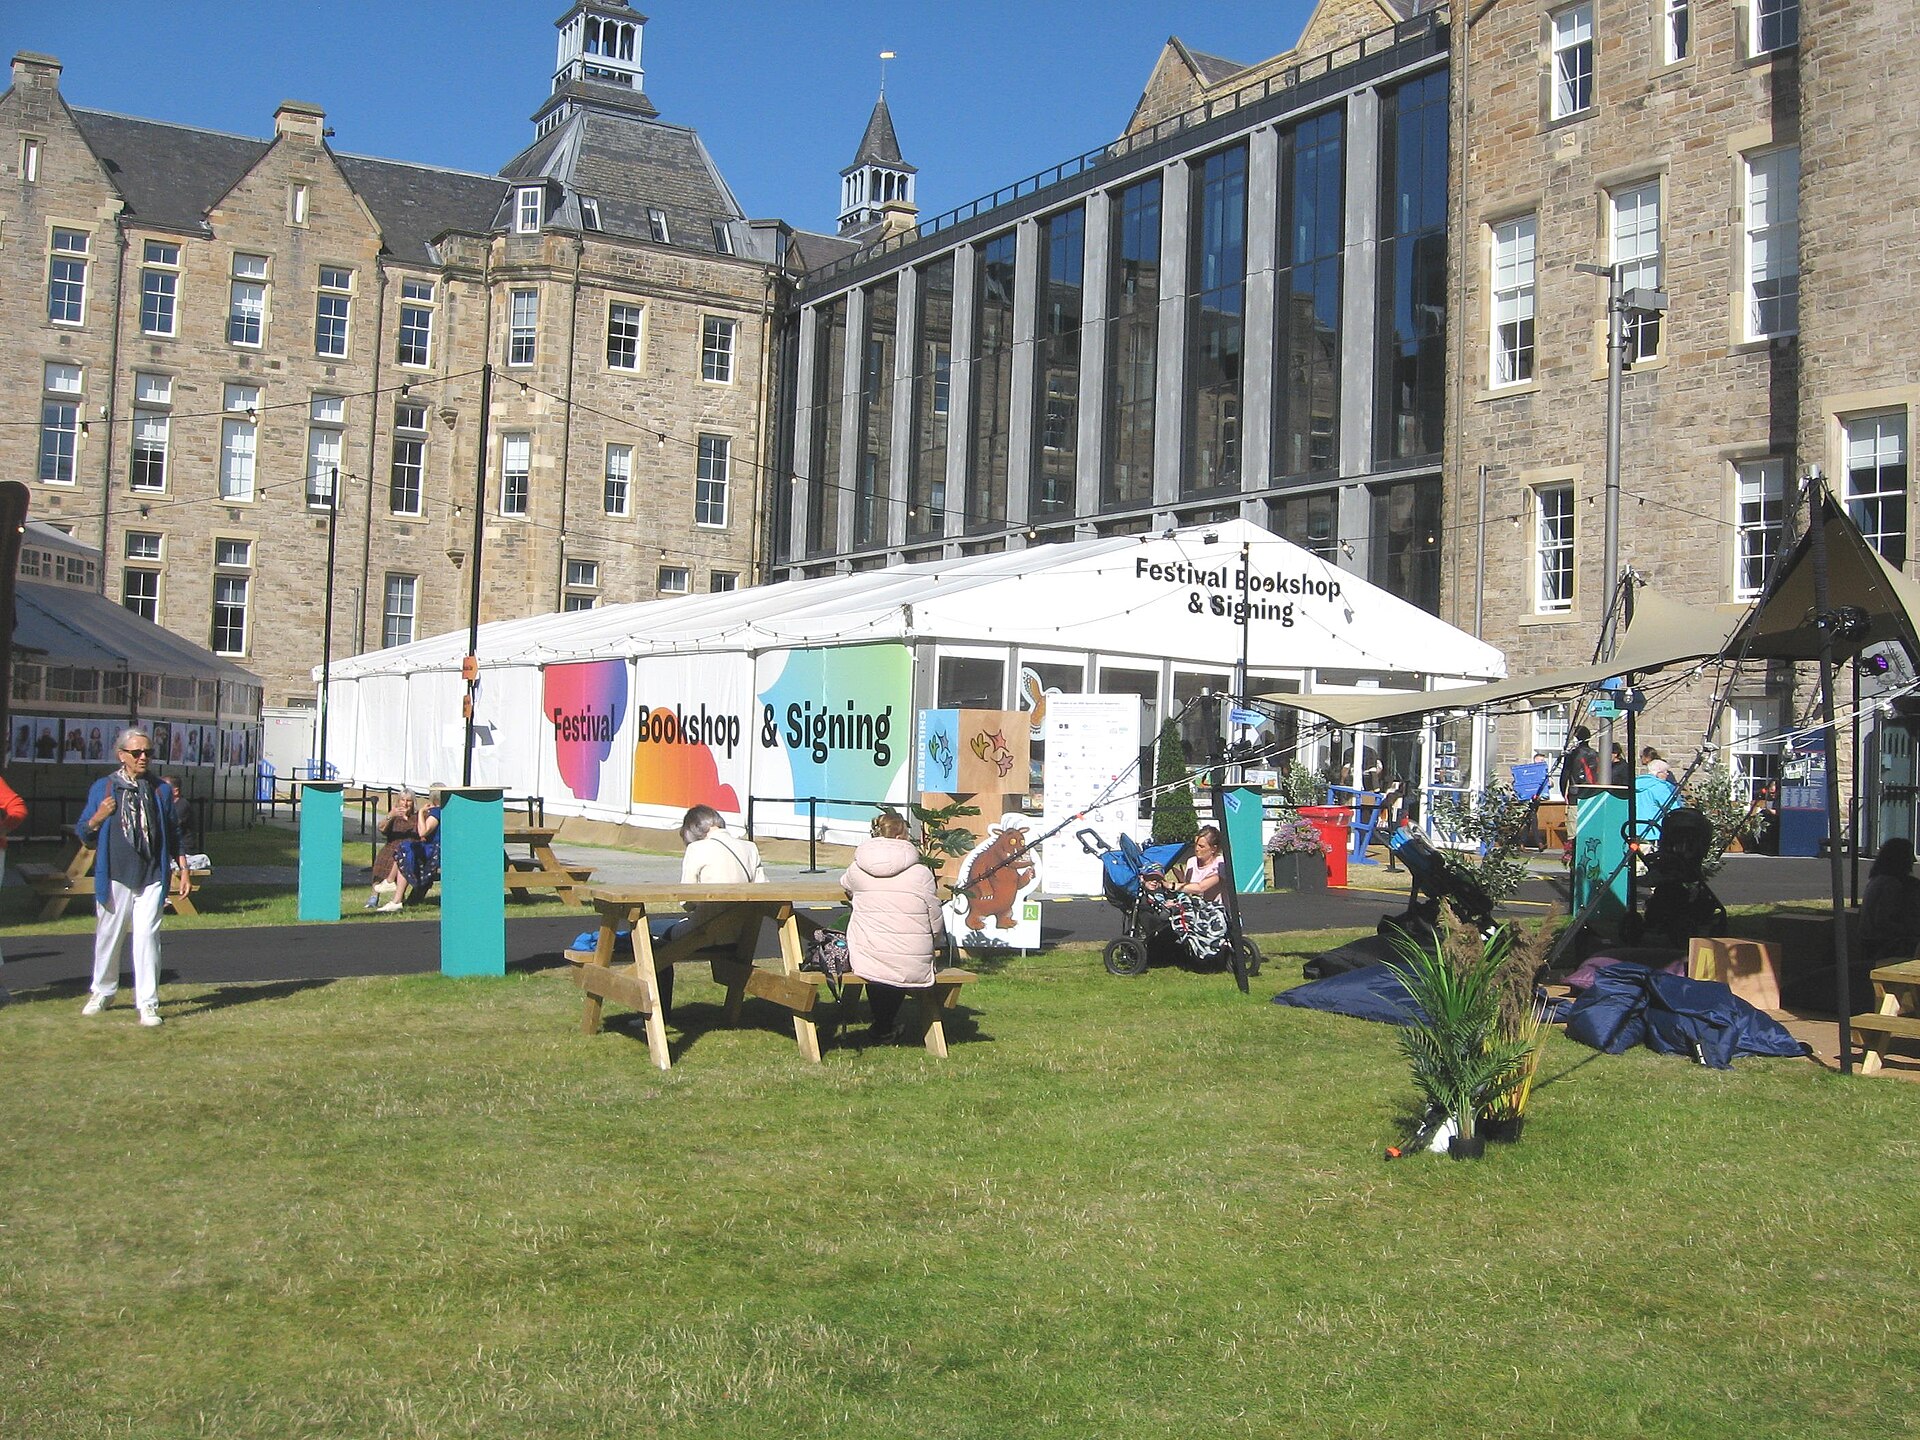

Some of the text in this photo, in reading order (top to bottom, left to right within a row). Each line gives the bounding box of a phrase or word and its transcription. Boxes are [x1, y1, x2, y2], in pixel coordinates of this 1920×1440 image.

[1136, 557, 1341, 602] Festival Bookshop
[1188, 592, 1294, 627] & Signing
[554, 700, 892, 766] Festival Bookshop & Signing
[917, 710, 926, 791] CHILDREN'S
